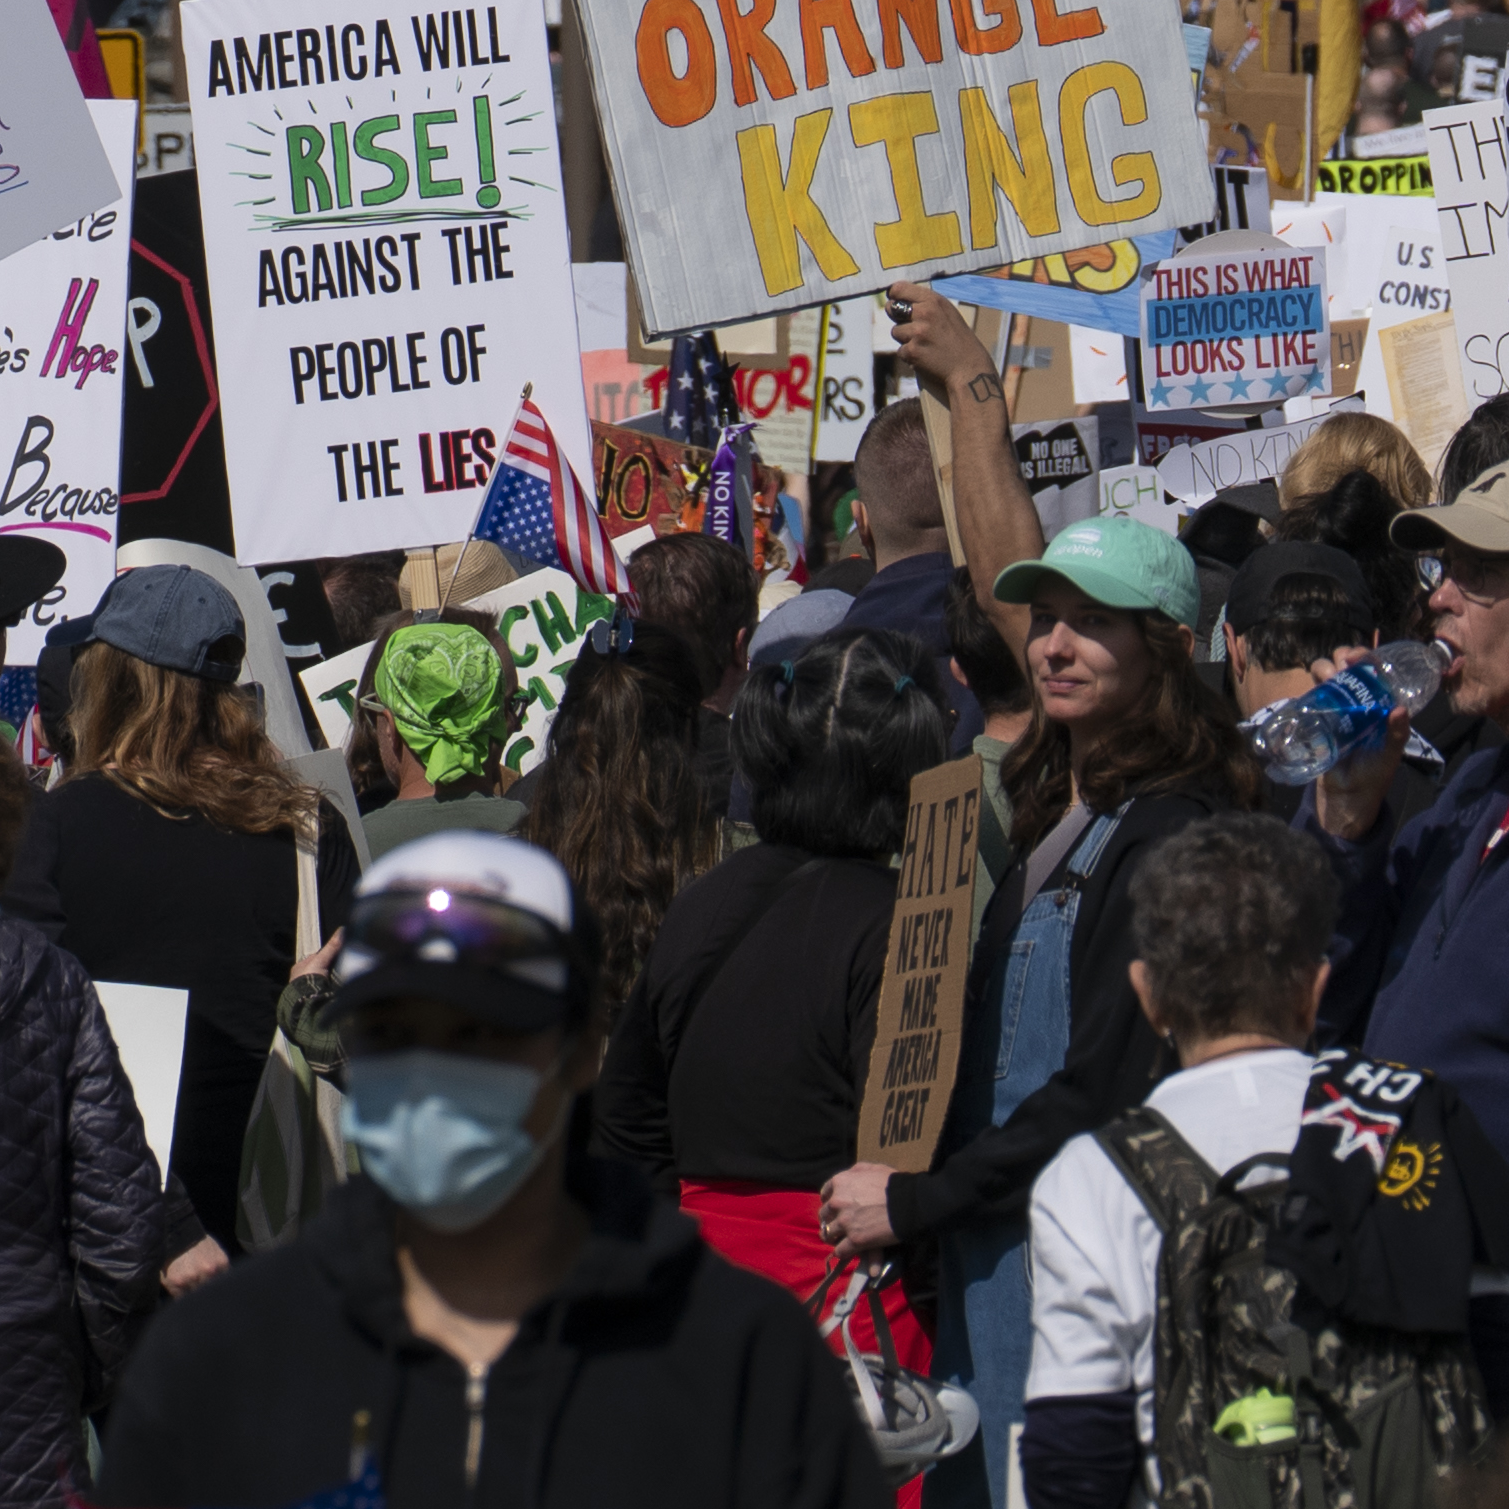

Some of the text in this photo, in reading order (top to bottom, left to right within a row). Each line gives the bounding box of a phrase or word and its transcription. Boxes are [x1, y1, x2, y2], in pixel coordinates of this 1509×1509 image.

[208, 6, 511, 98] AMERICA WILL
[285, 94, 502, 214] RISE!
[736, 59, 1163, 297] KING
[258, 220, 514, 308] AGAINST THE
[1151, 264, 1209, 302] THIS
[1216, 261, 1239, 297] IS
[1243, 255, 1314, 294] WHAT
[1153, 292, 1314, 339] DEMOCRACY
[289, 324, 488, 404] PEOPLE OF
[1155, 333, 1245, 378] LOOKS
[1256, 328, 1317, 368] LIKE
[328, 427, 496, 502] THE LIES
[1030, 437, 1078, 460] NO ONE
[1036, 455, 1090, 478] ILLEGAL
[1190, 443, 1243, 498] NO
[714, 471, 731, 502] NO
[898, 788, 979, 900] HATE
[896, 907, 954, 974] NEVER
[899, 974, 942, 1033] MADE
[883, 1030, 943, 1091] AMERICA
[879, 1088, 931, 1149] GREAT
